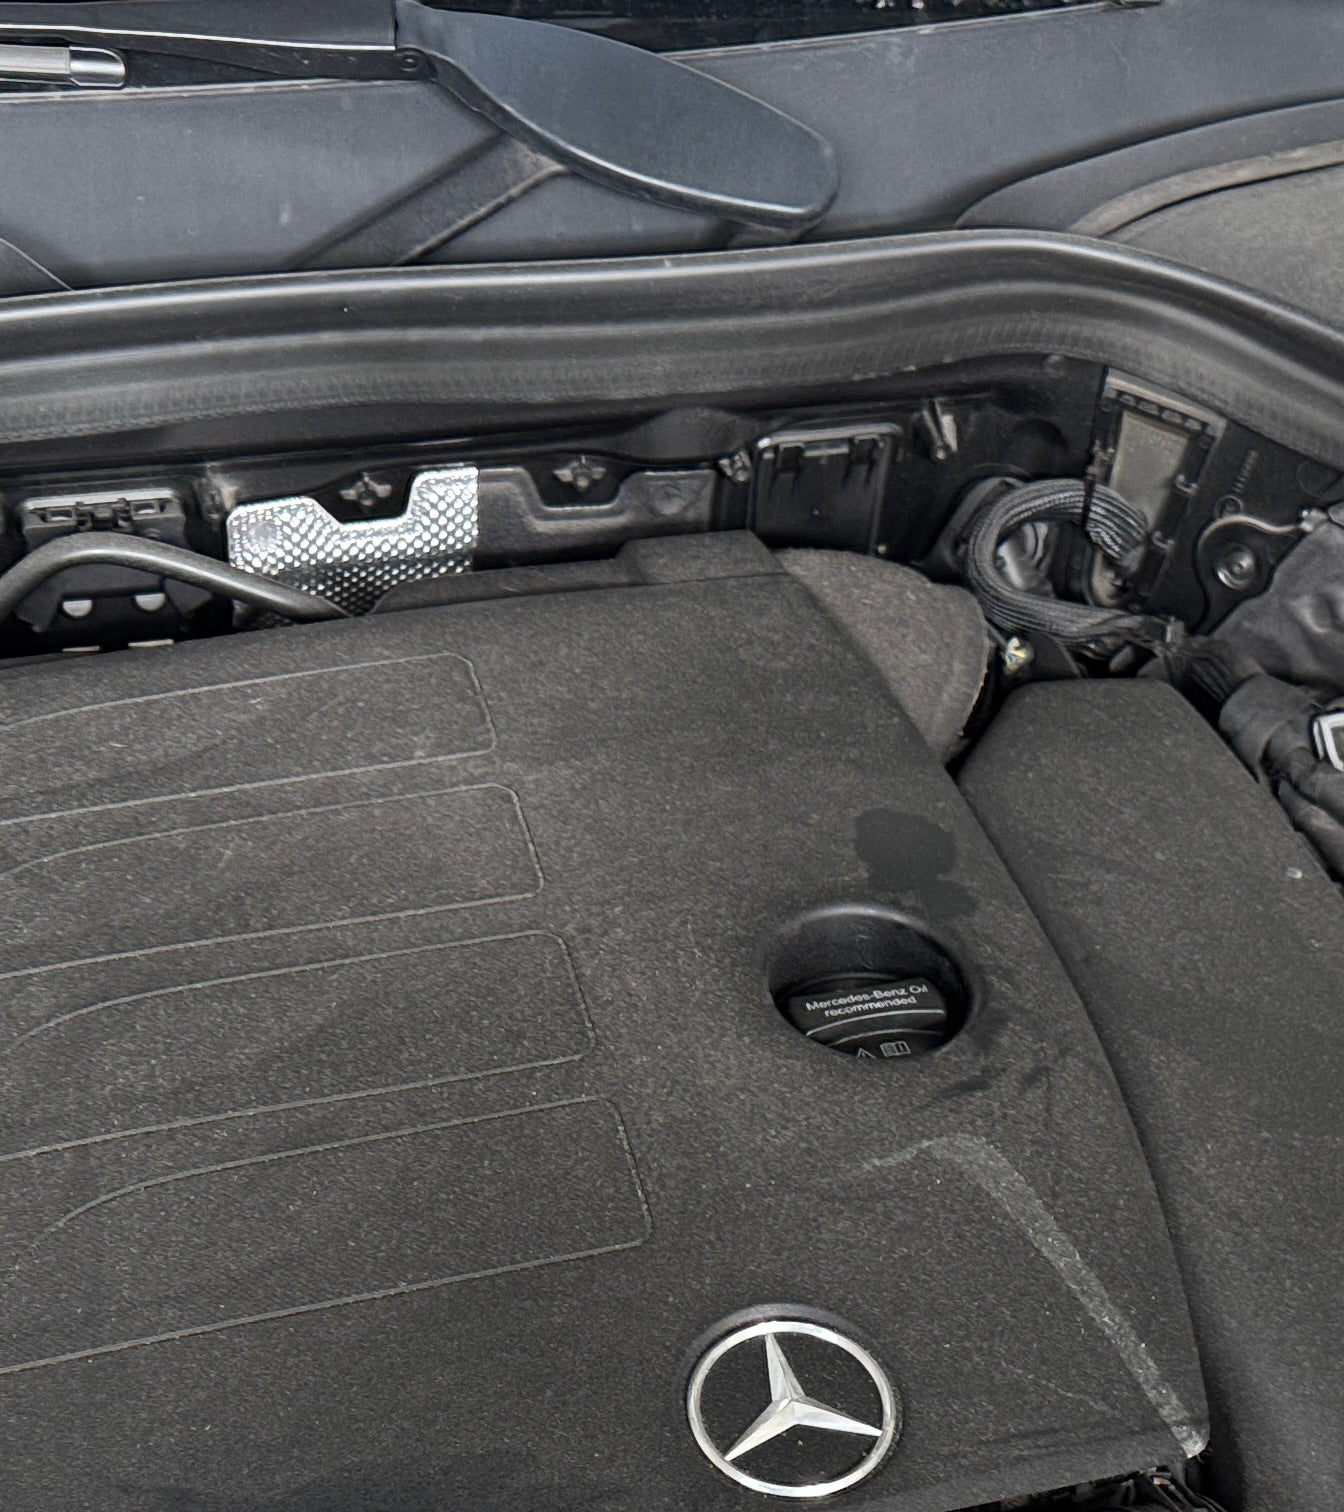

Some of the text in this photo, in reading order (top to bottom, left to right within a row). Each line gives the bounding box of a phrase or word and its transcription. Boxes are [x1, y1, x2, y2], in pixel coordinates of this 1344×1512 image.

[805, 984, 929, 1011] Mercedes-Benz Oil
[824, 996, 917, 1018] recommended
